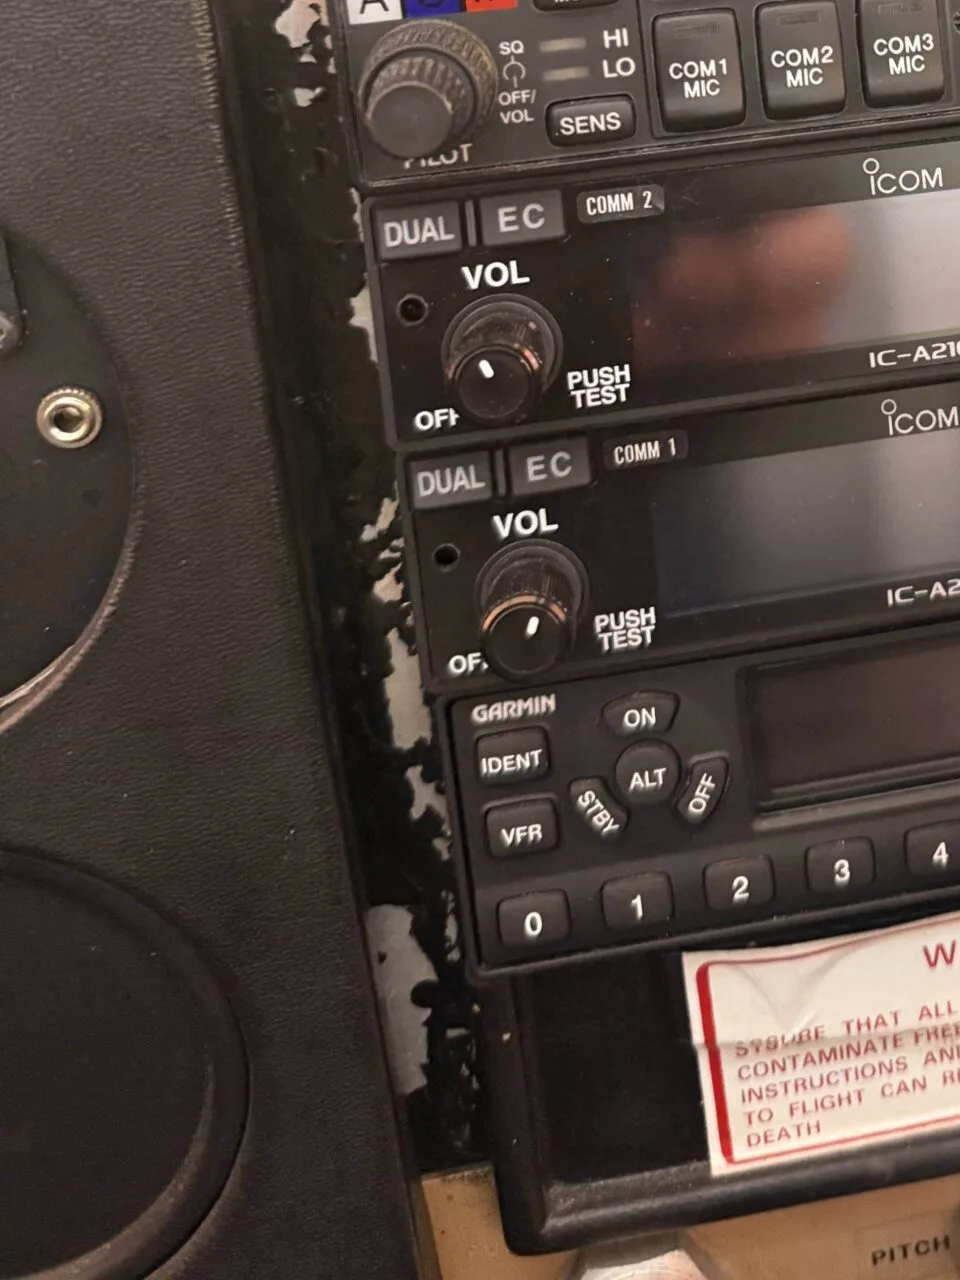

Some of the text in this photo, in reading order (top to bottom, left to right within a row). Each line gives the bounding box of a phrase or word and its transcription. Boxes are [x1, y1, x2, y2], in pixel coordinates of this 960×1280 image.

[499, 40, 524, 56] SQ
[602, 27, 629, 49] HI
[873, 33, 935, 57] COM3
[602, 56, 636, 79] LO
[669, 58, 728, 80] COM1
[770, 45, 835, 68] COM2
[889, 54, 926, 76] MIC
[684, 78, 721, 99] MIC
[785, 67, 824, 88] MIC
[498, 88, 537, 107] OFF/
[499, 108, 535, 125] VOL
[560, 111, 622, 136] SENS
[586, 190, 654, 216] COMM 2
[384, 215, 455, 248] DUAL
[461, 260, 530, 290] VOL
[566, 364, 632, 391] PUSH
[570, 383, 631, 409] TEST
[613, 437, 677, 465] COMM 1
[416, 464, 486, 497] DUAL
[492, 508, 559, 539] VOL
[594, 606, 657, 634] PUSH
[598, 625, 656, 652] TEST
[471, 694, 557, 724] GARMIN
[622, 707, 657, 730] ON
[480, 749, 543, 776] IDENT
[629, 768, 667, 791] ALT
[687, 772, 716, 815] OFF
[577, 790, 620, 837] STBY
[501, 823, 543, 847] VFR
[931, 841, 949, 868] 4
[833, 859, 851, 885] 3
[731, 876, 750, 903] 2
[630, 894, 644, 920] 1
[524, 911, 543, 937] 0
[842, 1009, 902, 1036] THAT
[918, 1000, 959, 1022] ALL
[737, 1032, 904, 1081] CONTAMINATE
[740, 1055, 909, 1104] INSTRUCTIONS
[742, 1107, 774, 1126] TO
[788, 1088, 865, 1119] FLIGHT
[880, 1075, 928, 1099] CAN
[746, 1120, 822, 1148] DEATH
[870, 1235, 951, 1267] PITCH
